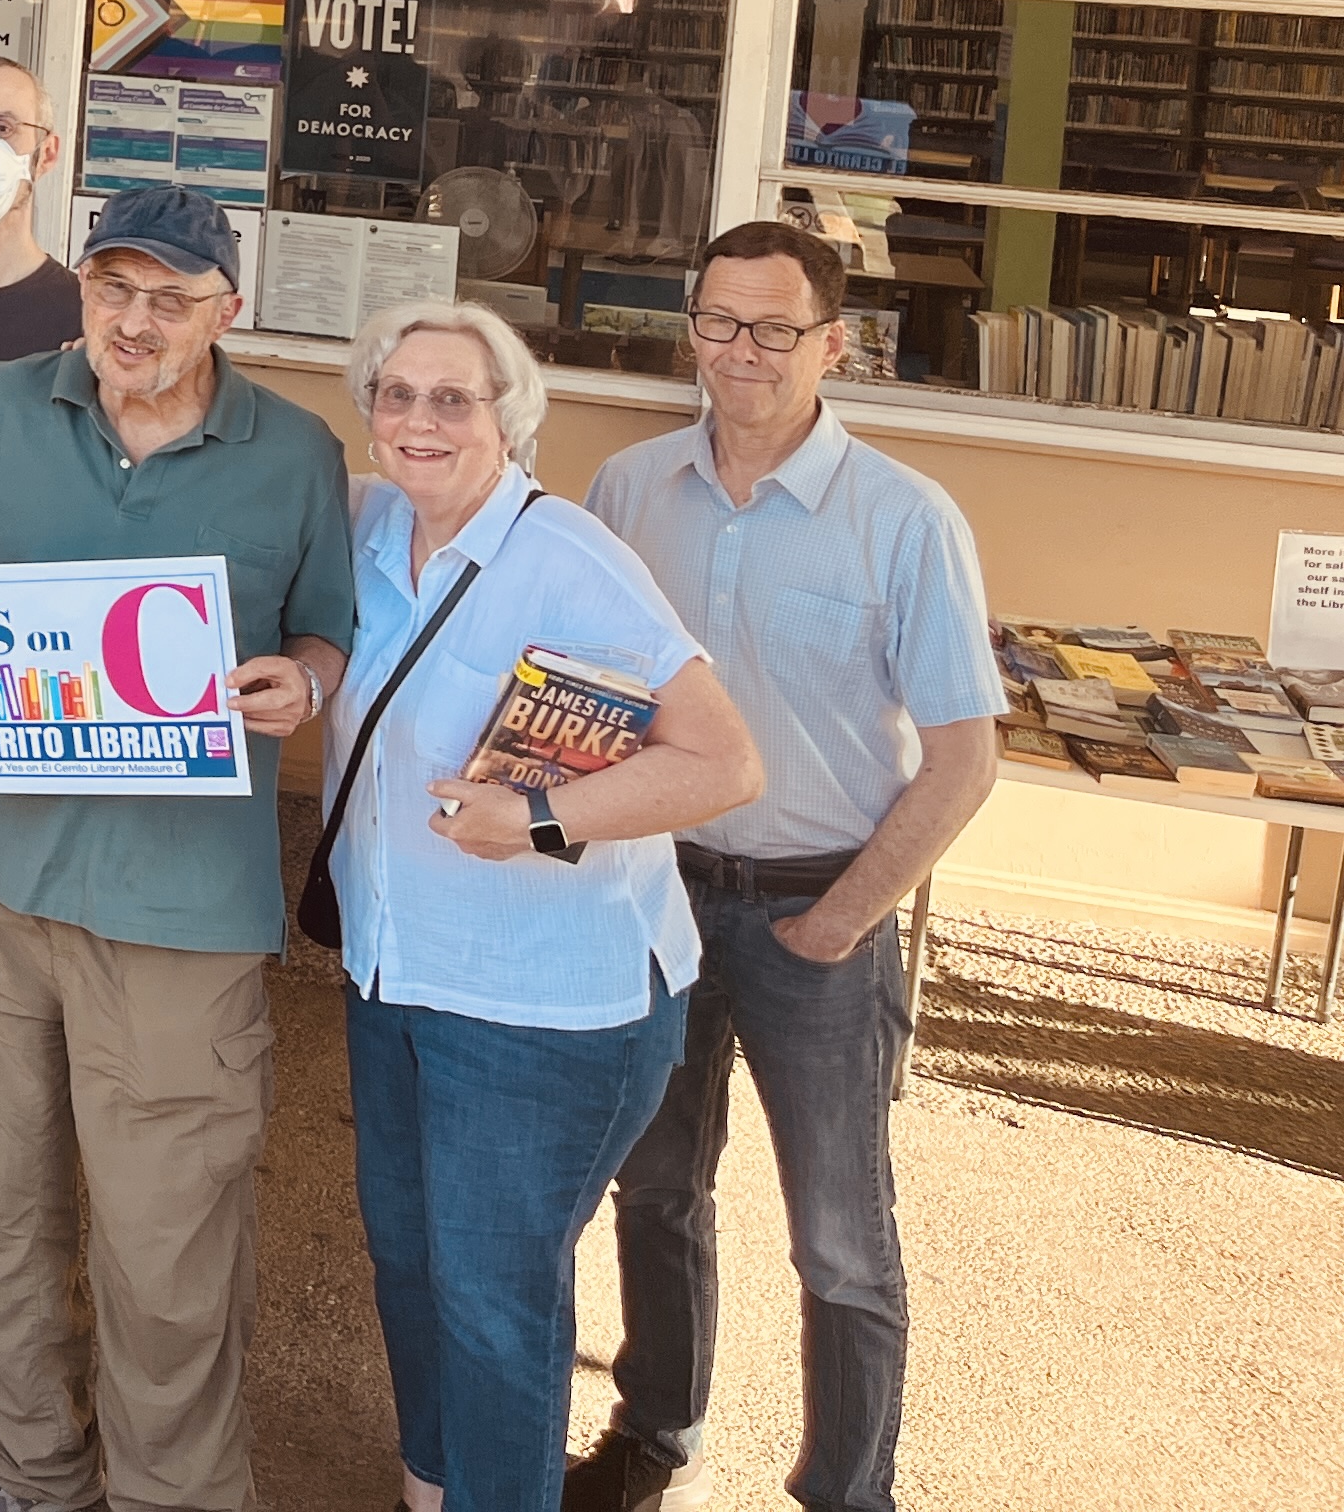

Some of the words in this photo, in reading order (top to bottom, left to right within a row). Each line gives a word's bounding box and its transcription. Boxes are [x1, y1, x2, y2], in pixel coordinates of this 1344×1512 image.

[339, 103, 372, 119] FOR
[297, 119, 412, 142] DEMOCRACY
[1303, 546, 1335, 557] More
[1304, 559, 1322, 569] for
[1325, 562, 1344, 570] sal
[1307, 574, 1328, 582] our
[1298, 585, 1329, 595] shelf
[1296, 598, 1317, 607] the
[1321, 599, 1344, 609] Libr
[27, 628, 73, 653] on
[101, 583, 219, 718] C
[531, 683, 598, 717] JAMES
[597, 703, 634, 728] LEE
[503, 696, 637, 763] BURKE
[72, 725, 201, 759] LIBRARY
[6, 763, 23, 773] Yes
[26, 765, 39, 773] on
[54, 763, 89, 773] Cerrito
[91, 763, 126, 775] Library
[128, 764, 173, 774] Measure
[176, 764, 184, 774] C
[509, 763, 566, 790] DON'
